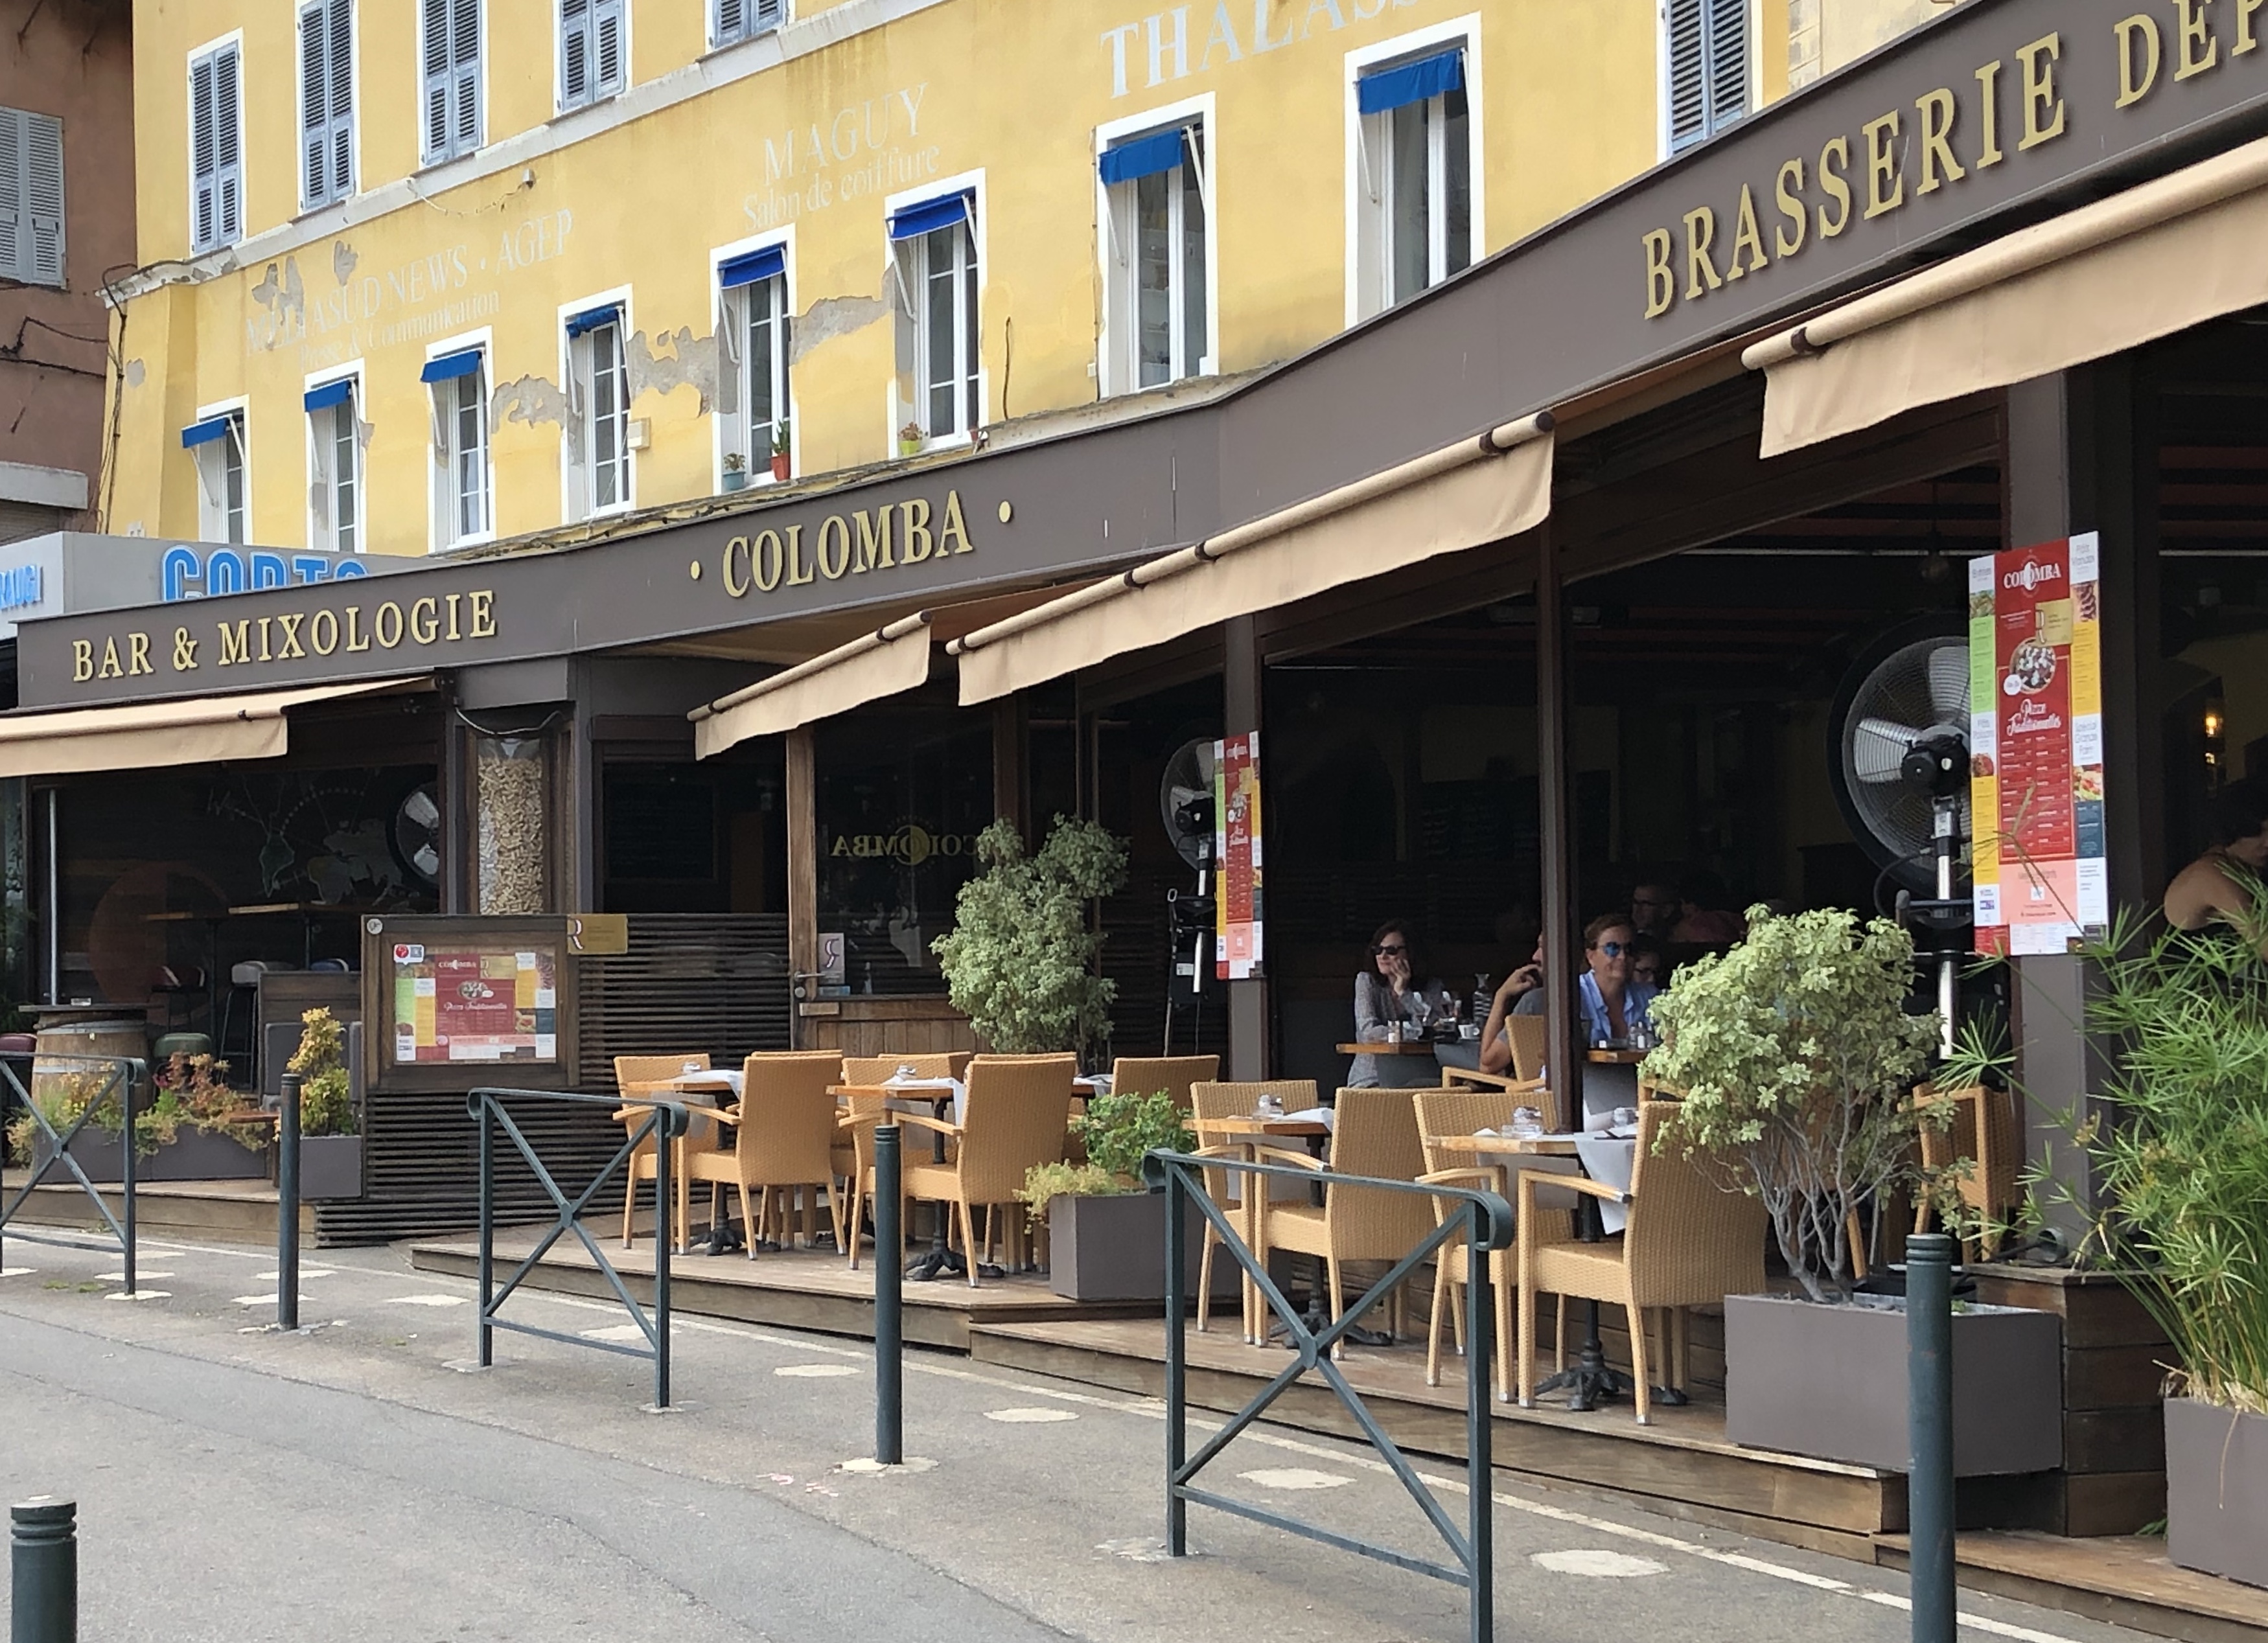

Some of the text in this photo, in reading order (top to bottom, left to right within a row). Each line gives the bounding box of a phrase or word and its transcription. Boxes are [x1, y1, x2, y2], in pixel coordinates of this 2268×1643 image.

[1100, 0, 1417, 99] THALA
[764, 82, 929, 187] MAGUY
[1643, 30, 2065, 320] BRASSERIE
[743, 145, 940, 231] Salon de coiffure
[388, 244, 468, 310] NEWS
[496, 209, 573, 275] AGEP
[723, 489, 974, 598] COLOMBA
[73, 590, 496, 682] BAR & MIXOLOGIE
